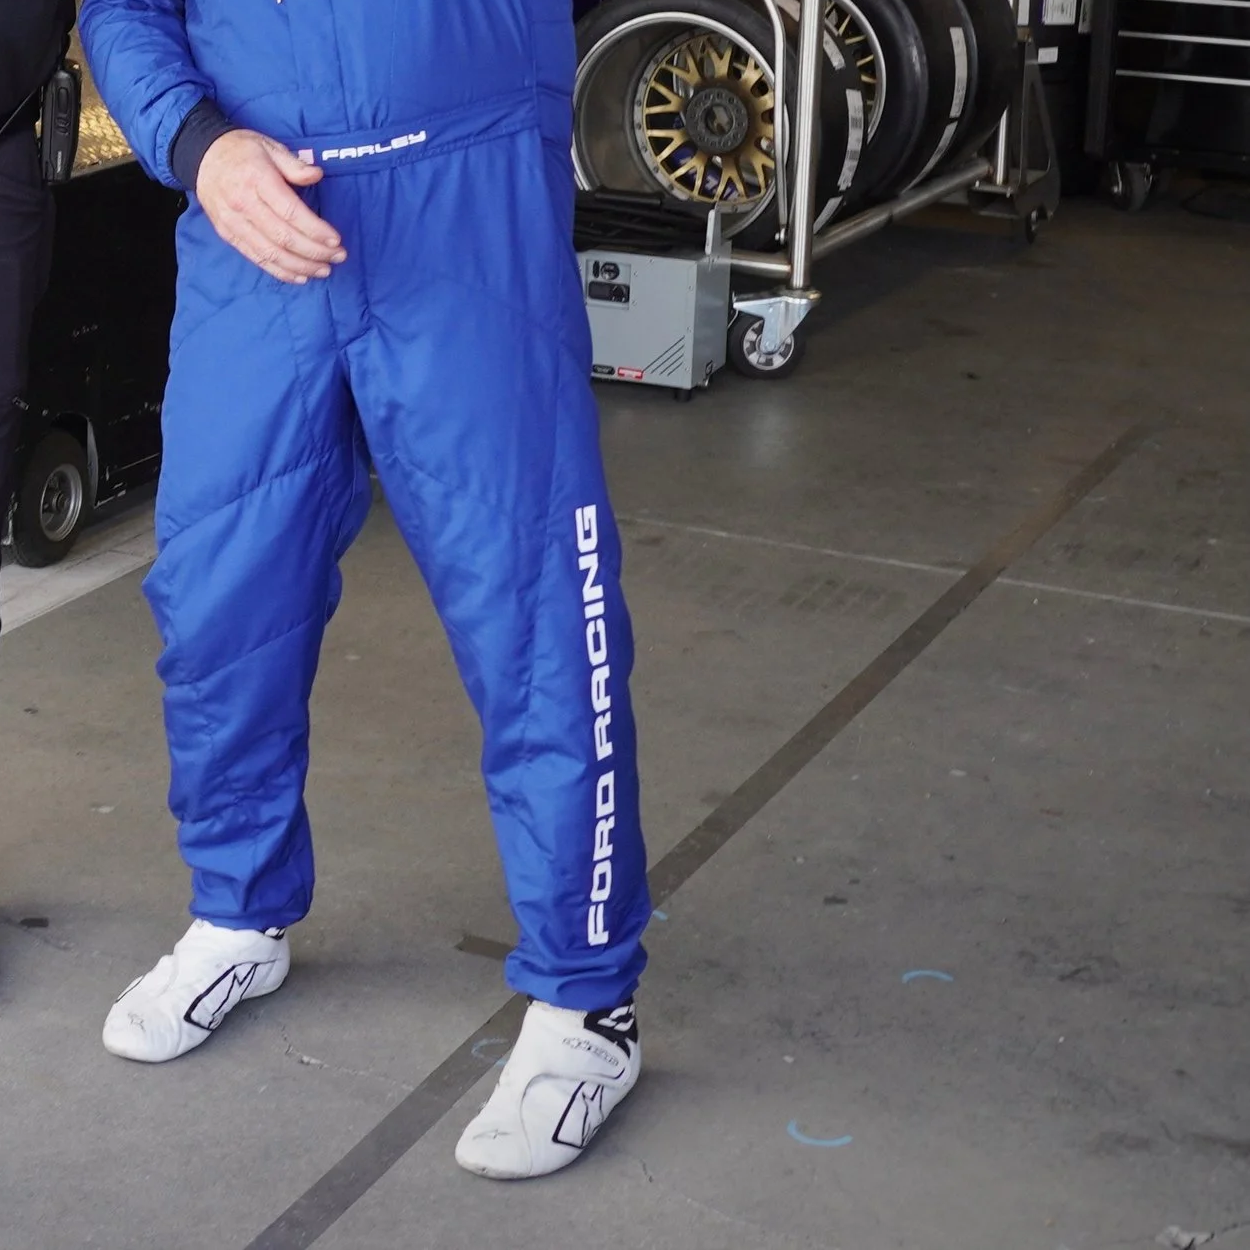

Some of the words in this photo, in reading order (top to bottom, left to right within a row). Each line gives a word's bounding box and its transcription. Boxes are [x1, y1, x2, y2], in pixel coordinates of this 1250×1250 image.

[321, 130, 427, 161] FARLEY
[574, 503, 614, 763] RACING
[586, 769, 616, 948] FORD
